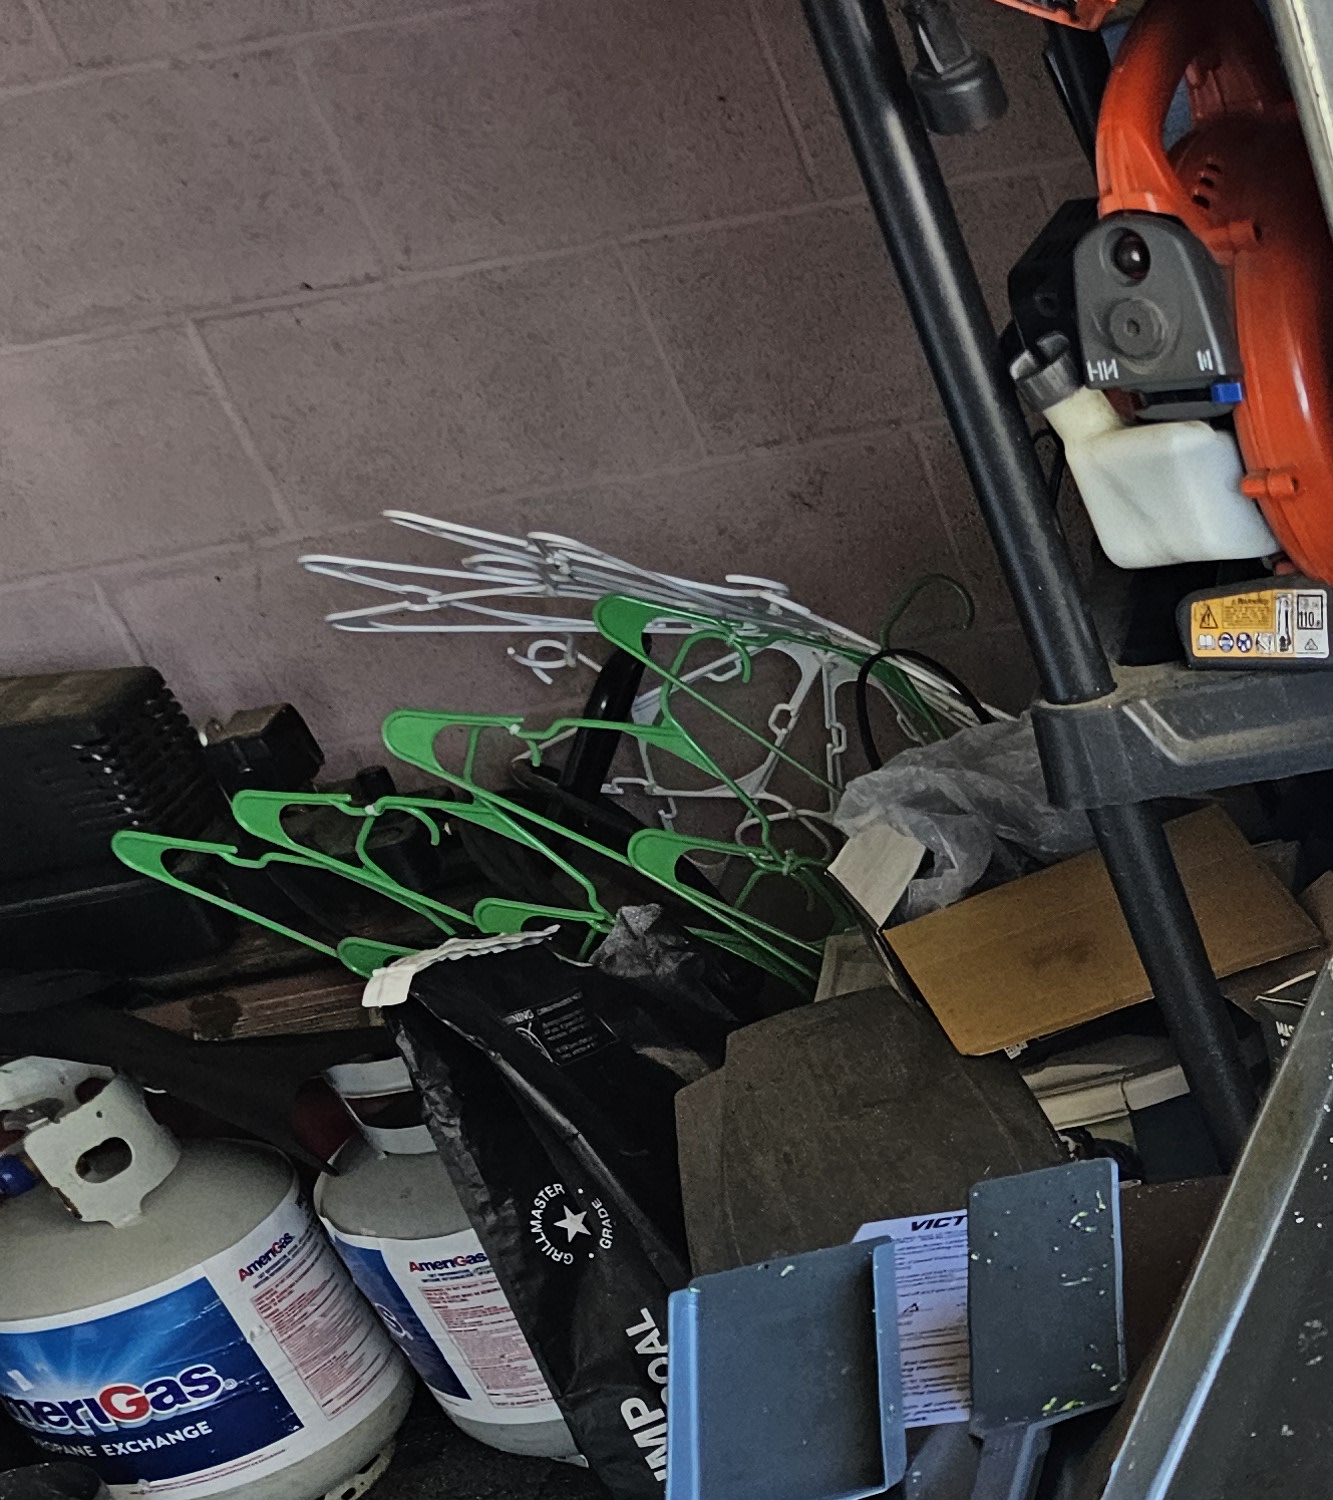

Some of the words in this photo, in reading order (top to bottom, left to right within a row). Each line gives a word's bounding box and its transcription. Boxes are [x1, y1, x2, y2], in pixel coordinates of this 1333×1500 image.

[529, 1183, 574, 1265] GRILLMASTER
[591, 1197, 613, 1249] GRADE
[911, 1215, 968, 1231] VICT
[238, 1232, 296, 1282] AmeriGas
[408, 1252, 488, 1273] AmeriGas
[625, 1307, 669, 1406] OAL
[2, 1363, 222, 1429] meriGas
[103, 1420, 213, 1457] EXCHANGE
